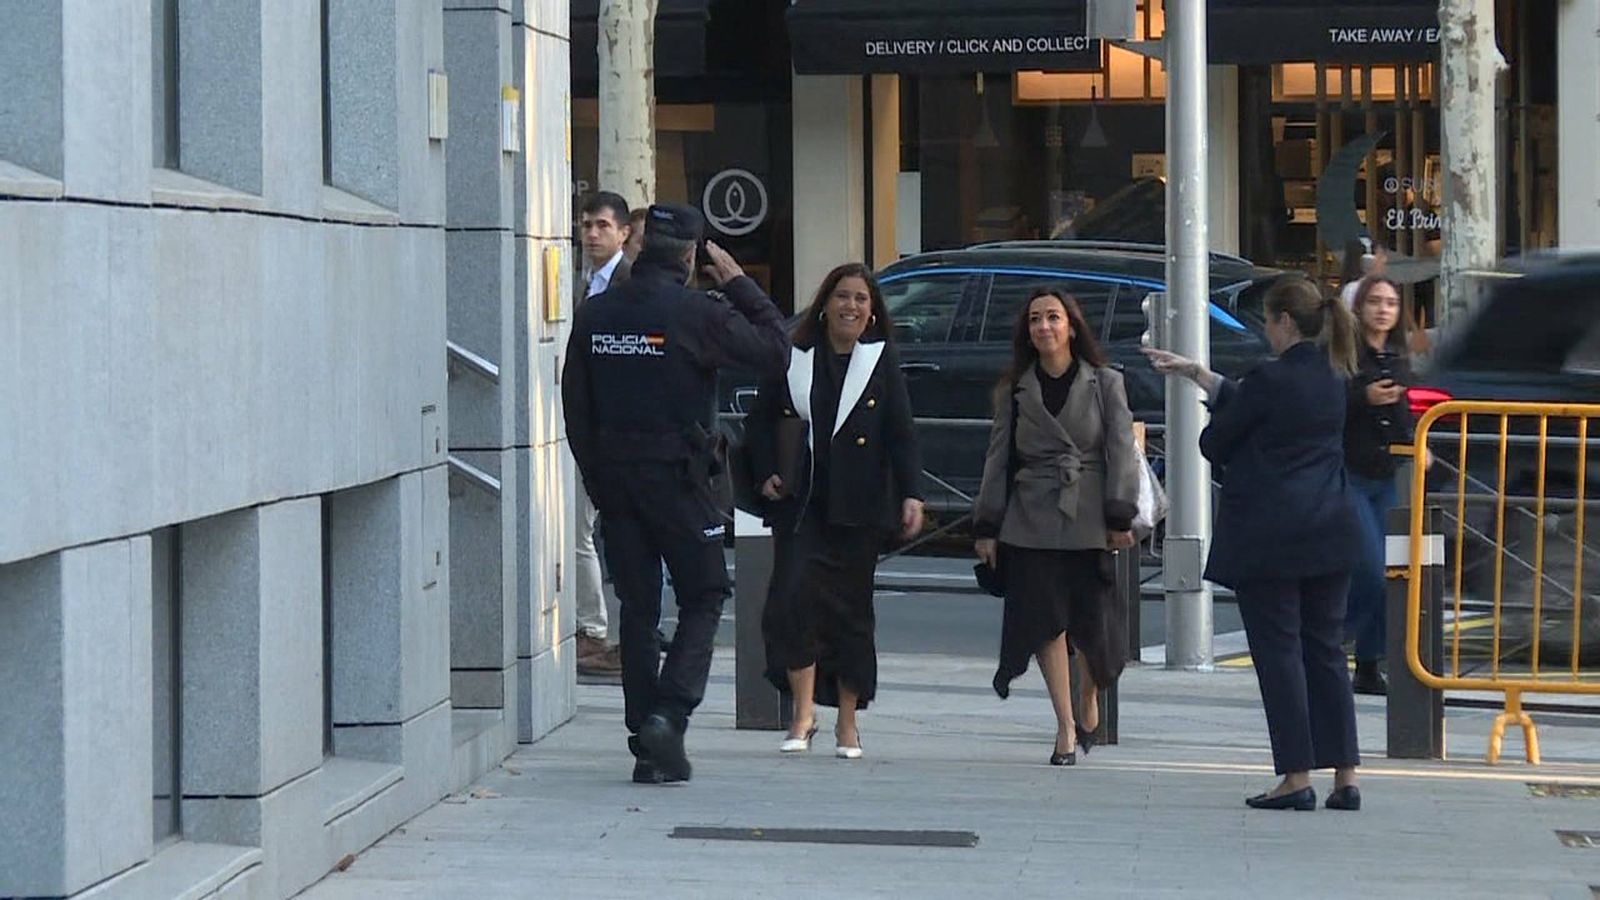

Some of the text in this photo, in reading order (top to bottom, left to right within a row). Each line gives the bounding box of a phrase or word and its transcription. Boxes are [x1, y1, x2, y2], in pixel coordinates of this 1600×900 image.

[1328, 28, 1367, 43] TAKE
[1371, 28, 1414, 43] AWAY
[865, 41, 935, 55] DELIVERY
[947, 39, 989, 54] CLICK
[992, 38, 1023, 53] AND
[591, 334, 648, 345] POLICIA
[591, 345, 665, 355] NACIONAL
